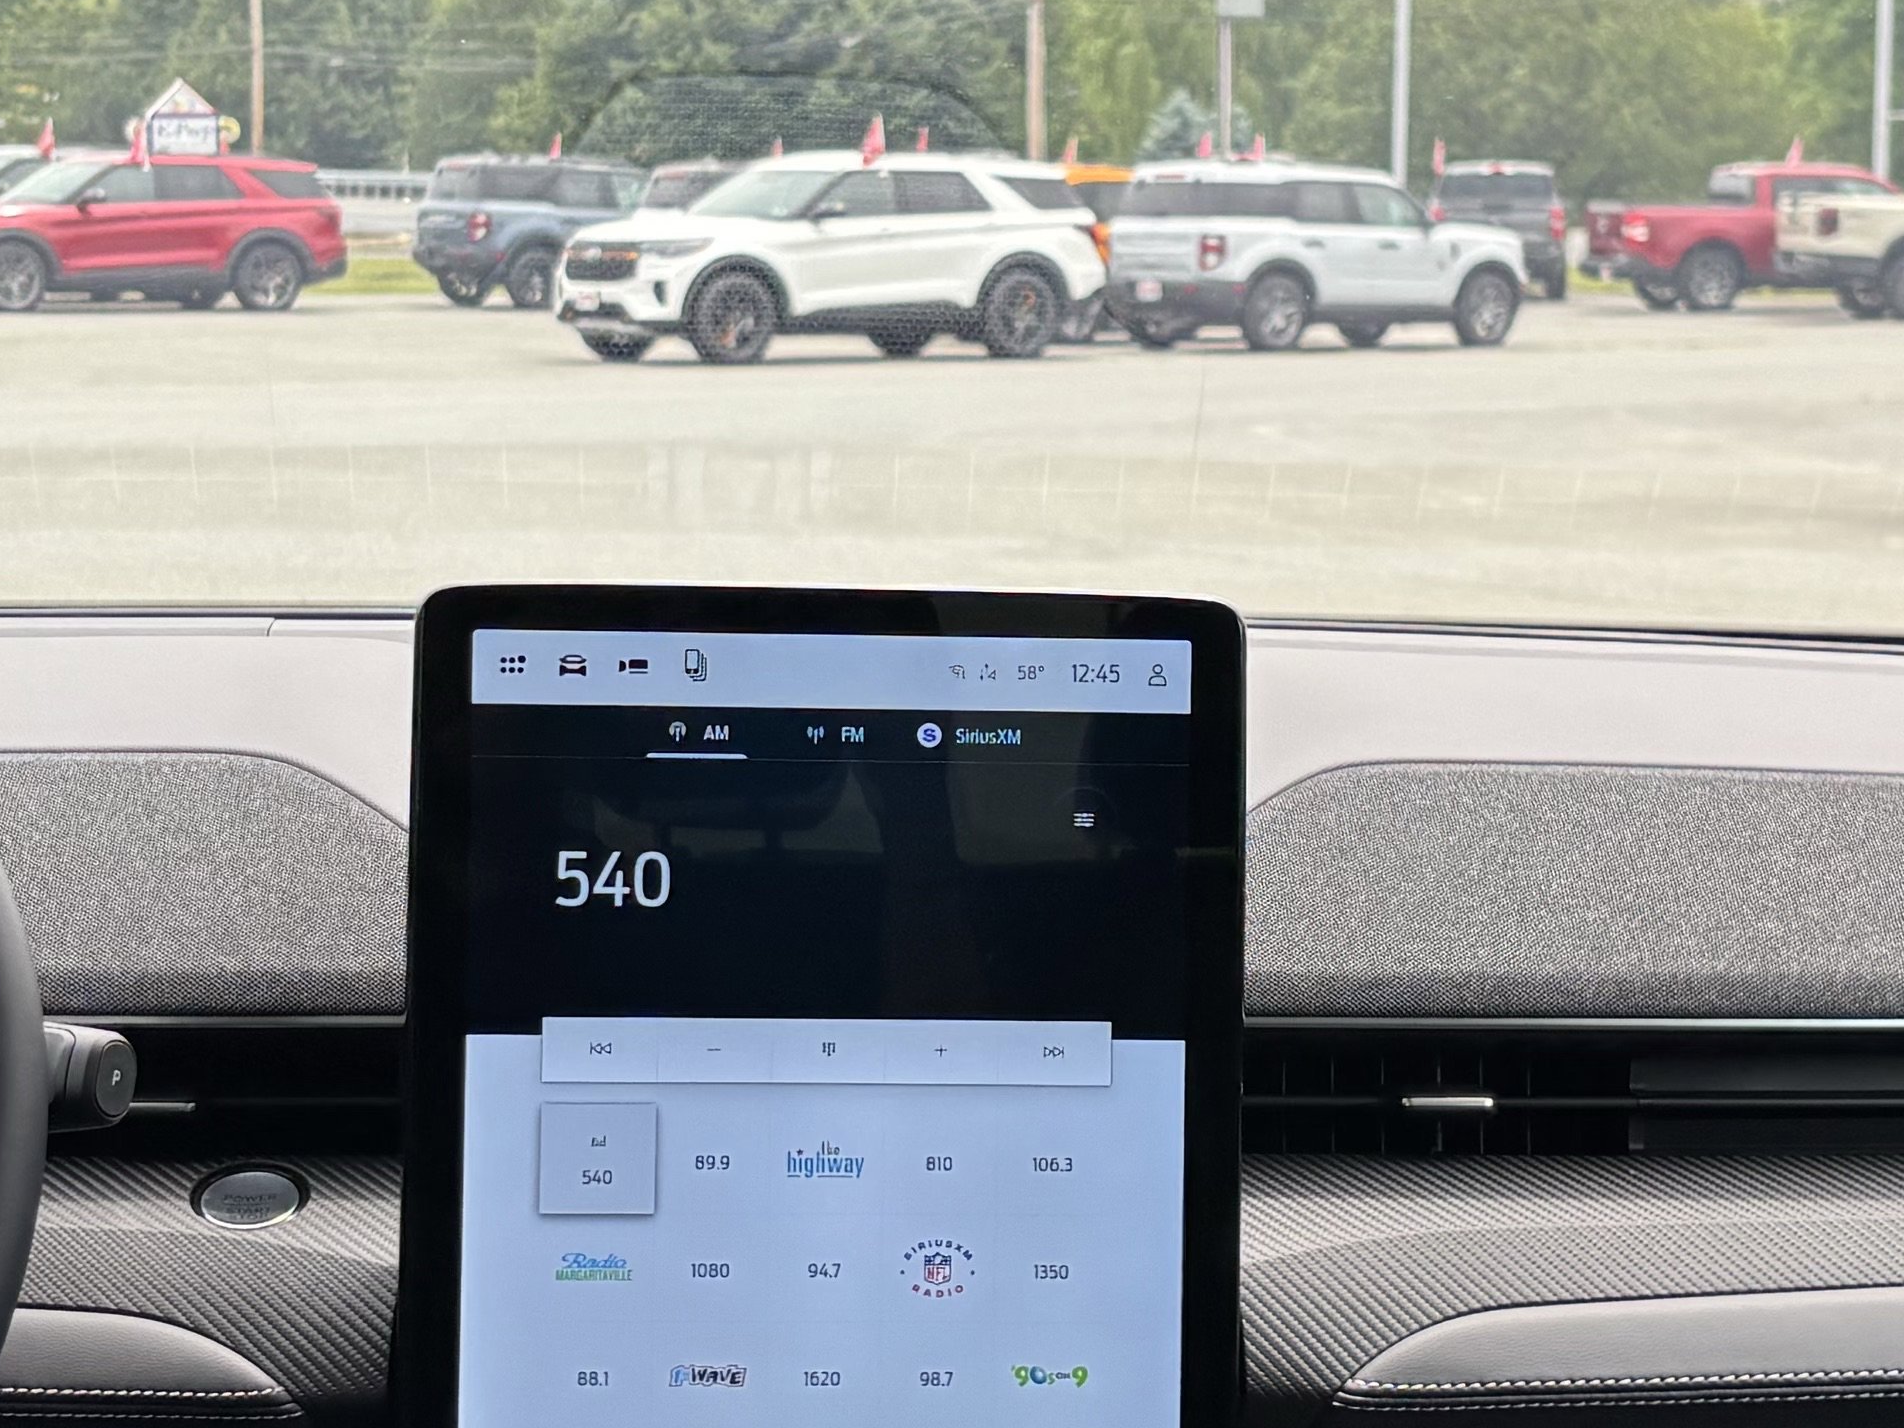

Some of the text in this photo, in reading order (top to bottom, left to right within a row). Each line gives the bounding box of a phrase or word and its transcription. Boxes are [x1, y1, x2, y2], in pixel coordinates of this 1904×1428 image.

[1017, 663, 1121, 685] 58° 12:45
[703, 725, 1022, 746] AM FM SiriusXM
[554, 851, 672, 908] 540
[112, 1069, 121, 1086] P
[694, 1148, 1073, 1180] 89.9 highway 810 106.3
[582, 1169, 613, 1187] 540
[690, 1262, 730, 1280] 1080
[807, 1262, 842, 1280] 94.7
[927, 1267, 947, 1281] NFL
[1032, 1263, 1069, 1281] 1350
[577, 1370, 610, 1388] 88.1
[803, 1370, 841, 1388] 1620
[919, 1370, 953, 1388] 98.7
